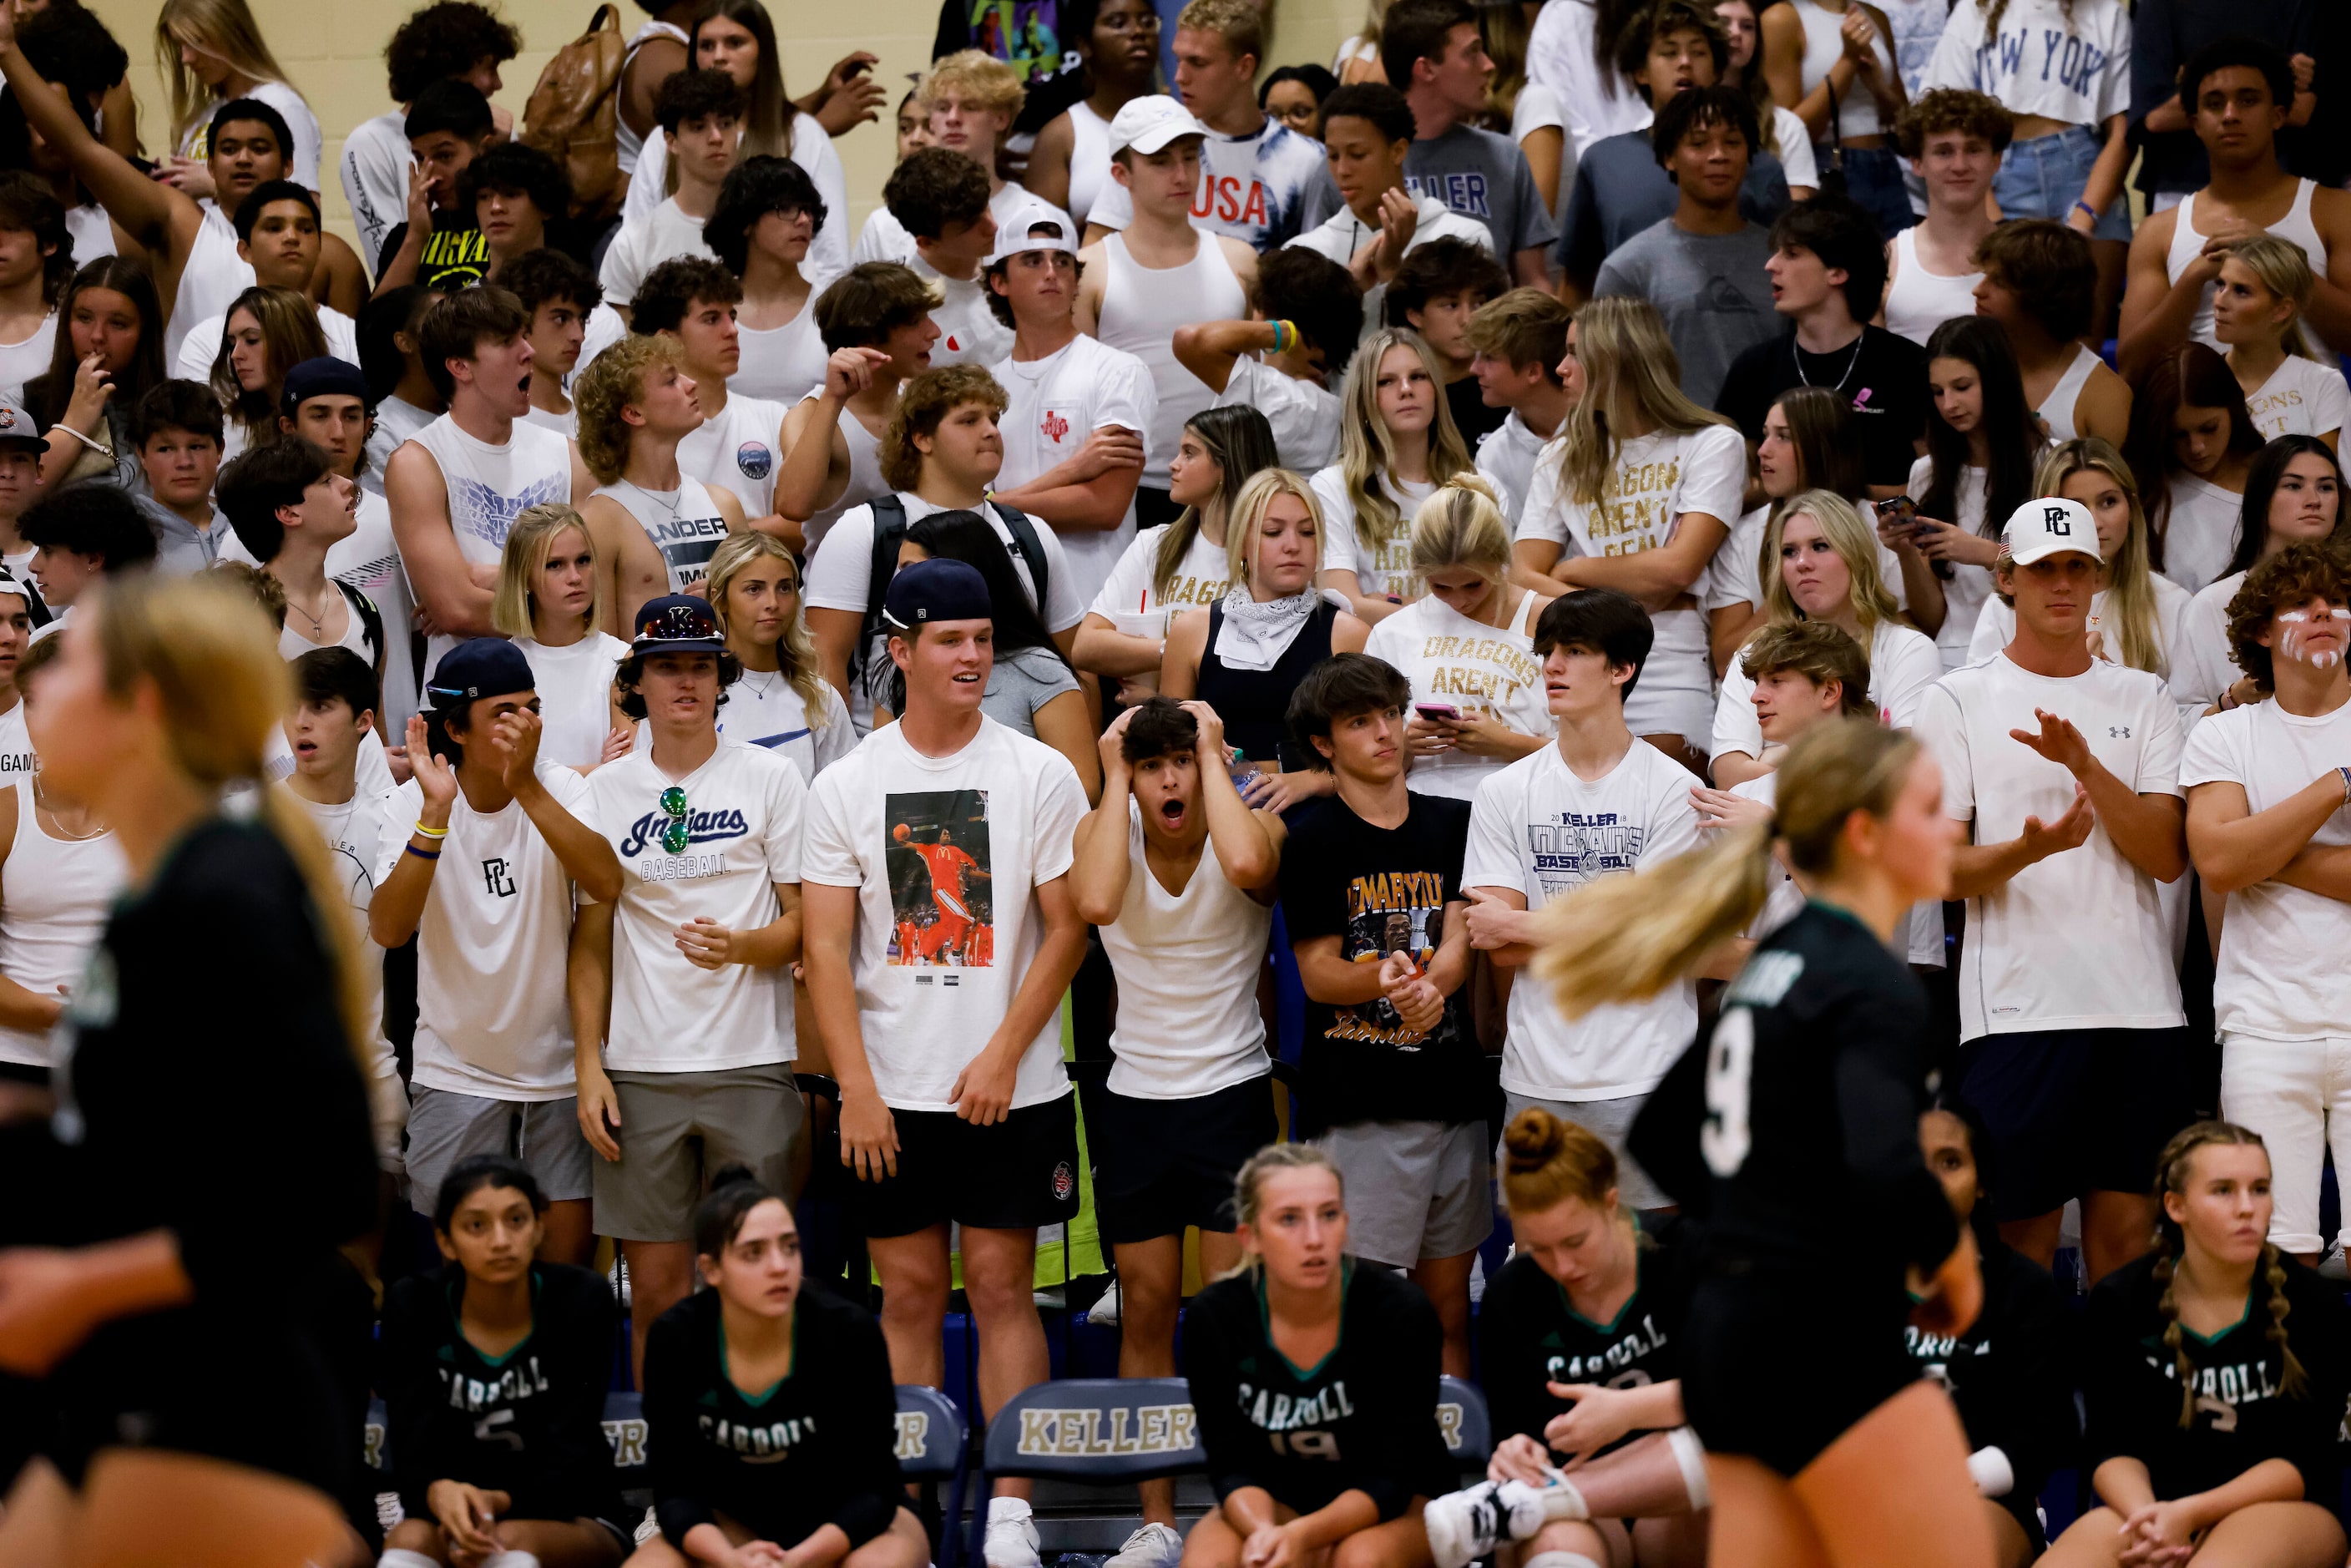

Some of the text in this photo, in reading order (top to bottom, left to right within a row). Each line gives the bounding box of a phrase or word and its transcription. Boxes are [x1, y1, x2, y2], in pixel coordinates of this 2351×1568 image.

[1189, 174, 1267, 225] USA
[1404, 171, 1492, 220] LER
[420, 228, 491, 266] IRVA
[2246, 390, 2303, 415] ONS
[645, 517, 729, 543] UNDER
[1155, 575, 1231, 607] RAG
[1423, 636, 1540, 689] DRAGONS
[1431, 666, 1520, 706] AREN'T
[620, 807, 749, 857] Inians
[1562, 812, 1617, 827] KELLER
[641, 853, 731, 882] BASEBALL
[1347, 870, 1444, 925] EMARYIU
[1700, 1004, 1755, 1178] 9
[2146, 1360, 2276, 1406] ROLL
[1017, 1403, 1197, 1457] KELLER
